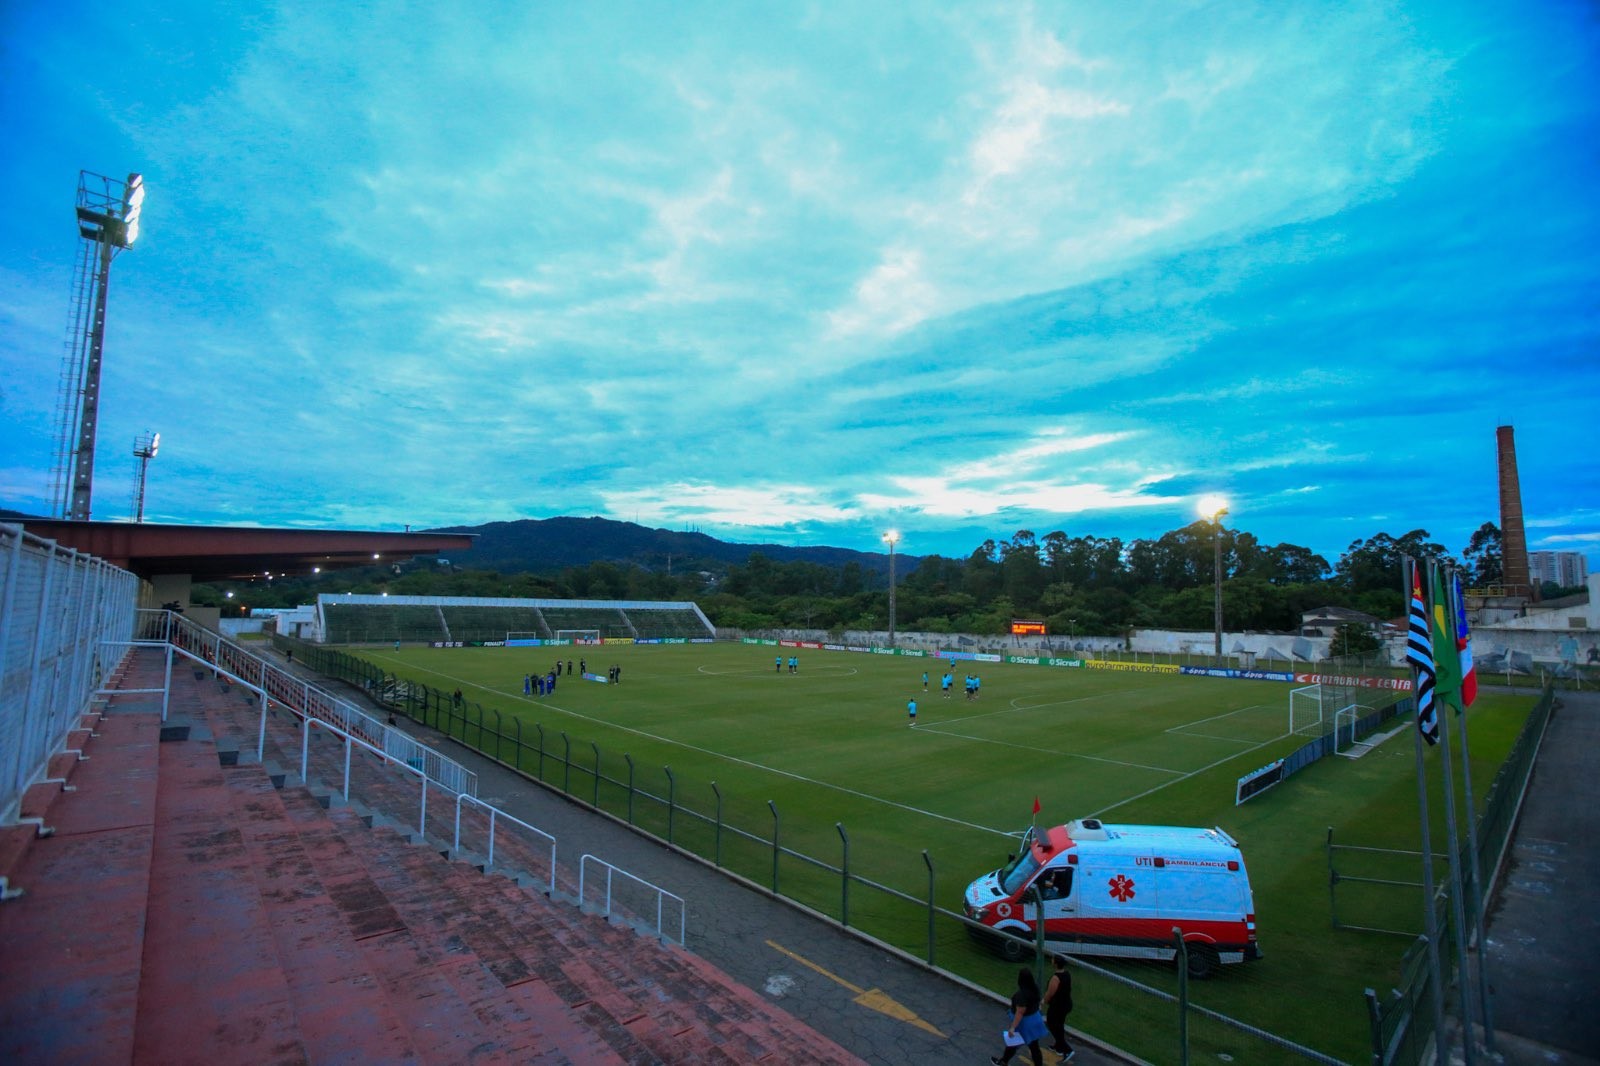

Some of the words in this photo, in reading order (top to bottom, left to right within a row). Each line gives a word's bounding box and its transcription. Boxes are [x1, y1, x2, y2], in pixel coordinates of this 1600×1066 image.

[1016, 657, 1039, 665] Sicredi
[1055, 658, 1080, 667] Sicredi
[1085, 661, 1130, 671] eurofarma
[1130, 664, 1179, 674] eurofarma
[1136, 857, 1152, 866] UTI
